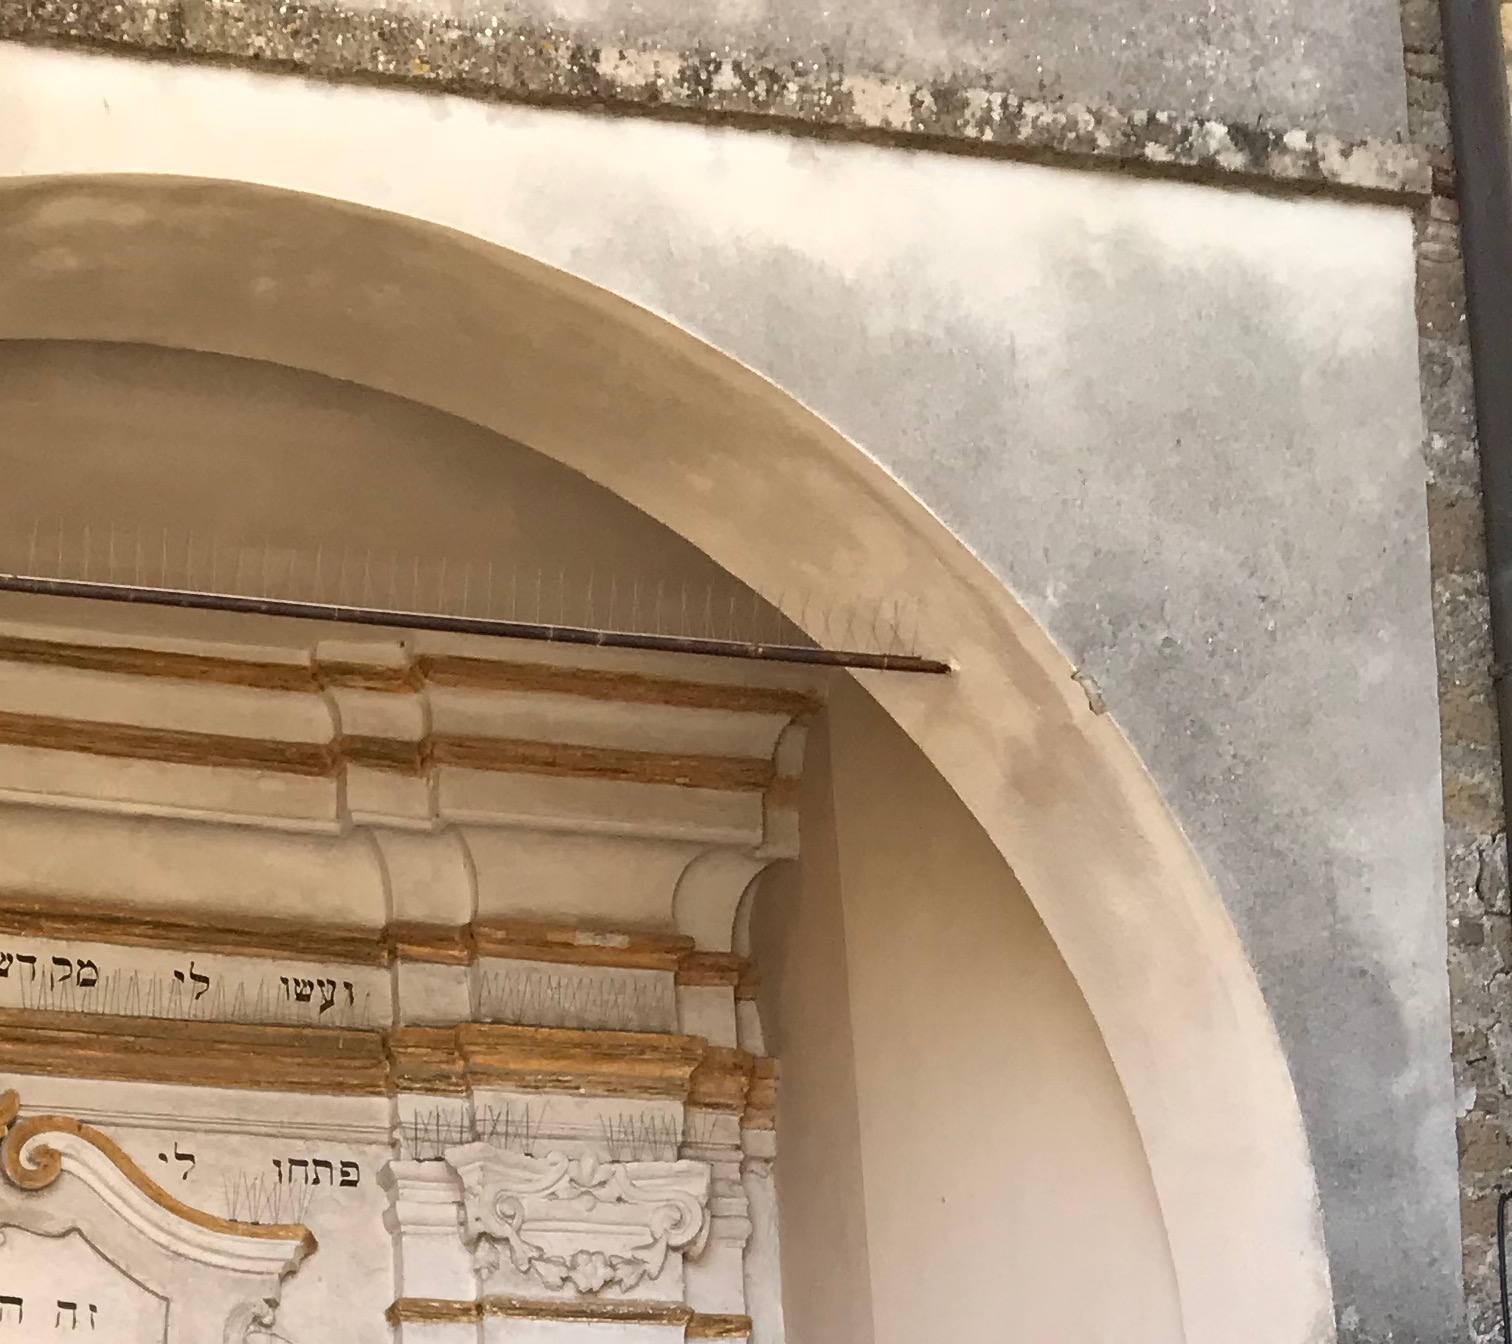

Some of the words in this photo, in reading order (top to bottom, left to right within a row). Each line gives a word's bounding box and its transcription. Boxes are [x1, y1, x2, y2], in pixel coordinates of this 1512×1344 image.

[173, 961, 210, 1000] לי
[279, 976, 355, 1015] ועשו
[158, 1141, 196, 1180] לי
[272, 1158, 360, 1187] פתחו
[55, 1299, 98, 1330] זה
